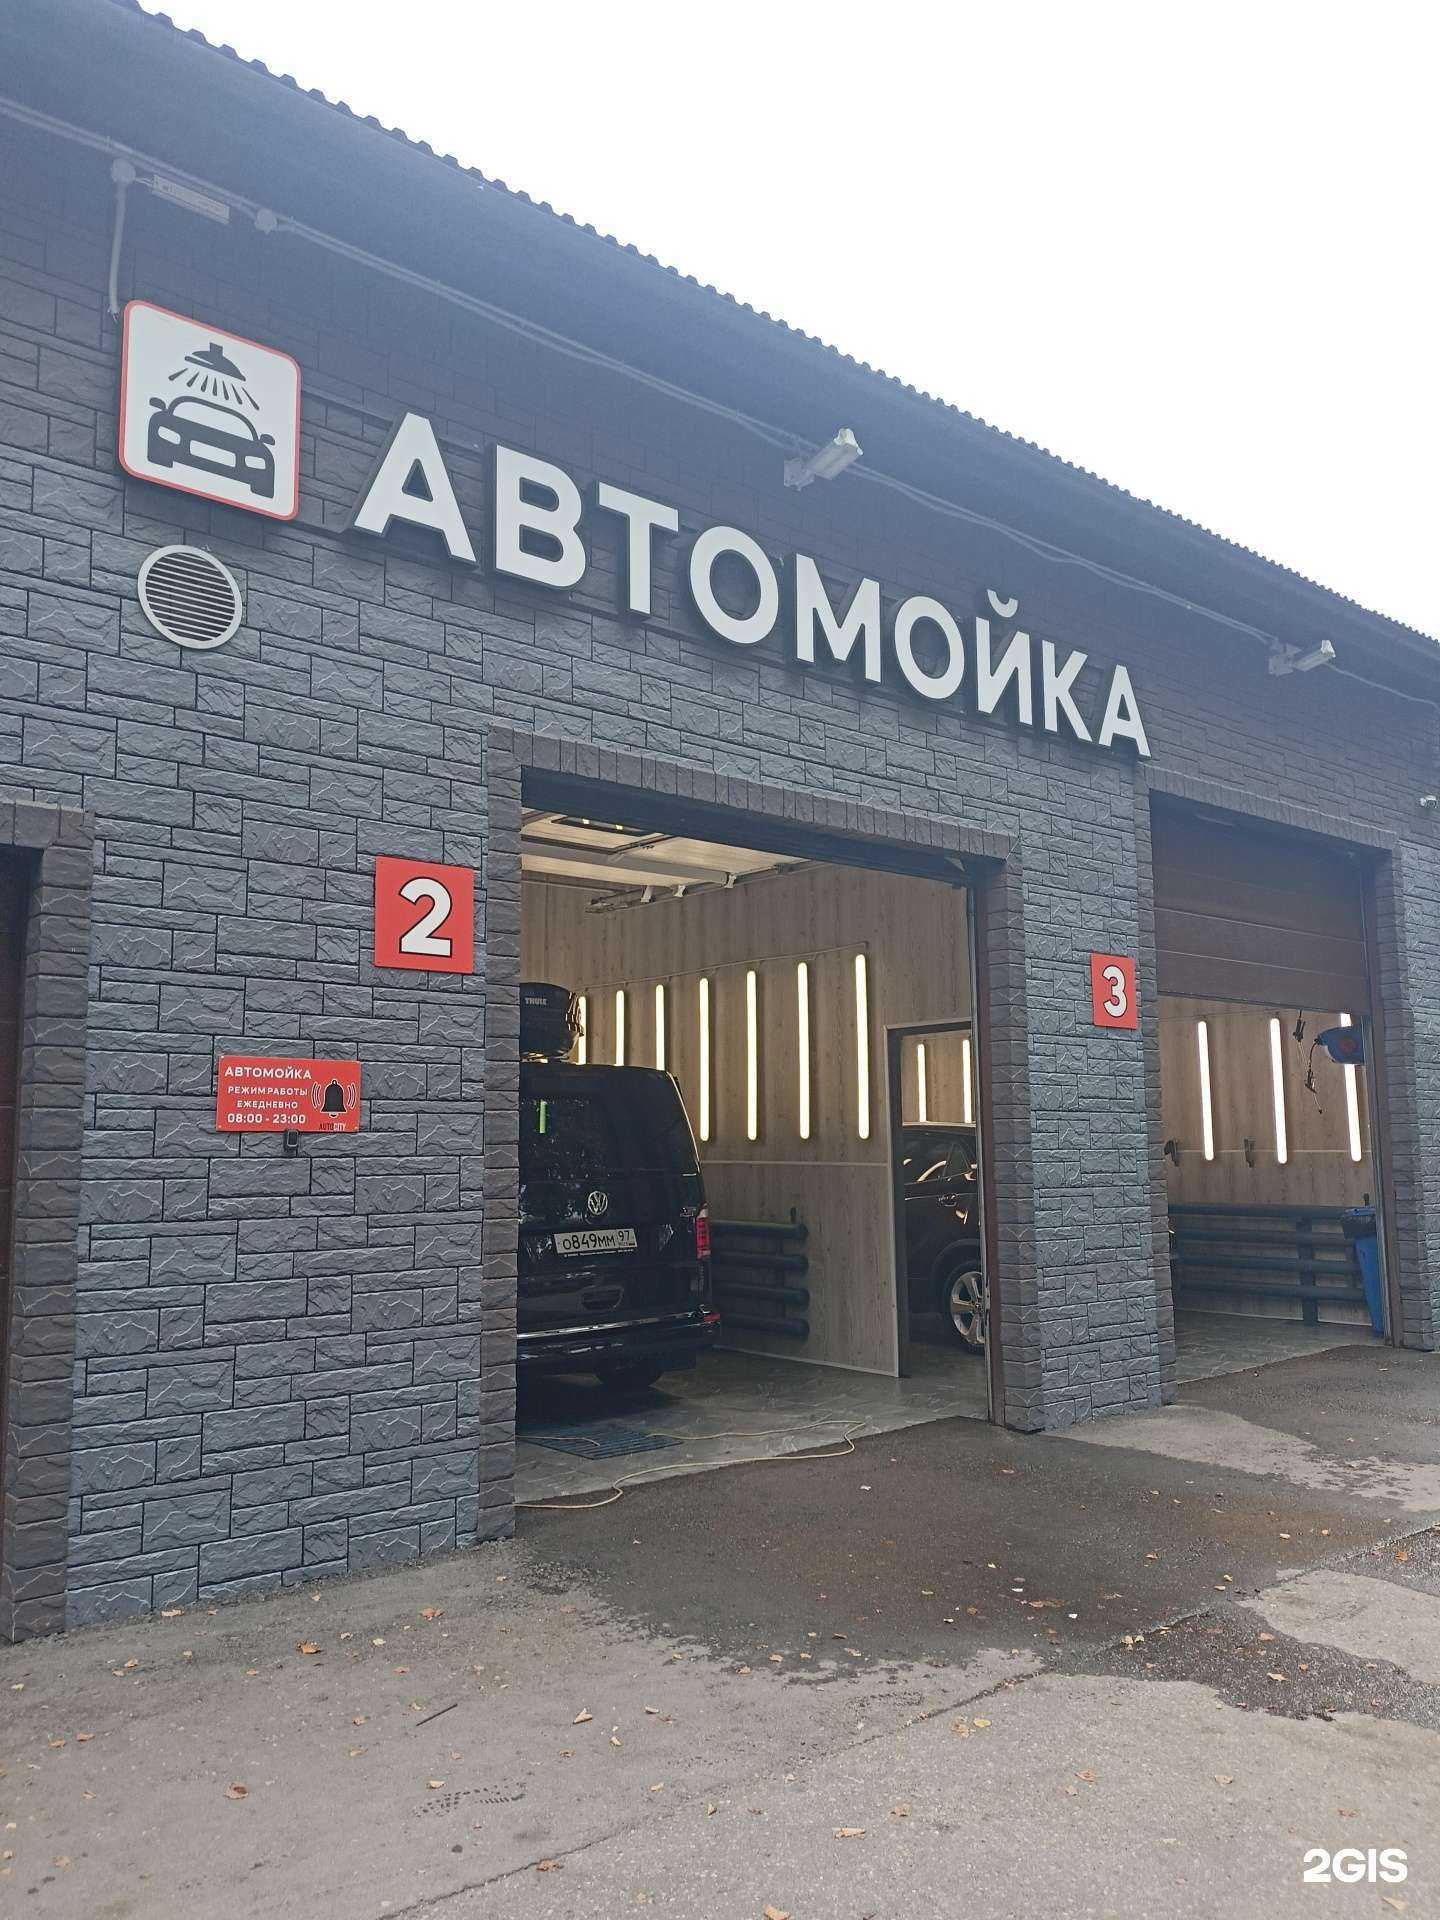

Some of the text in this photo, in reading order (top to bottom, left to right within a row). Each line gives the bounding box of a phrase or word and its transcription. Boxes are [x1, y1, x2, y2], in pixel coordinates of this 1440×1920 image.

[353, 411, 1153, 758] АВТОМОЙКА
[398, 876, 453, 958] 2
[1102, 964, 1128, 1018] 3
[224, 1066, 312, 1079] АВТОМОЙКА
[227, 1113, 263, 1123] 08:00
[272, 1114, 306, 1124] 23:00
[236, 1100, 298, 1109] ЕЖЕДНЕВНО
